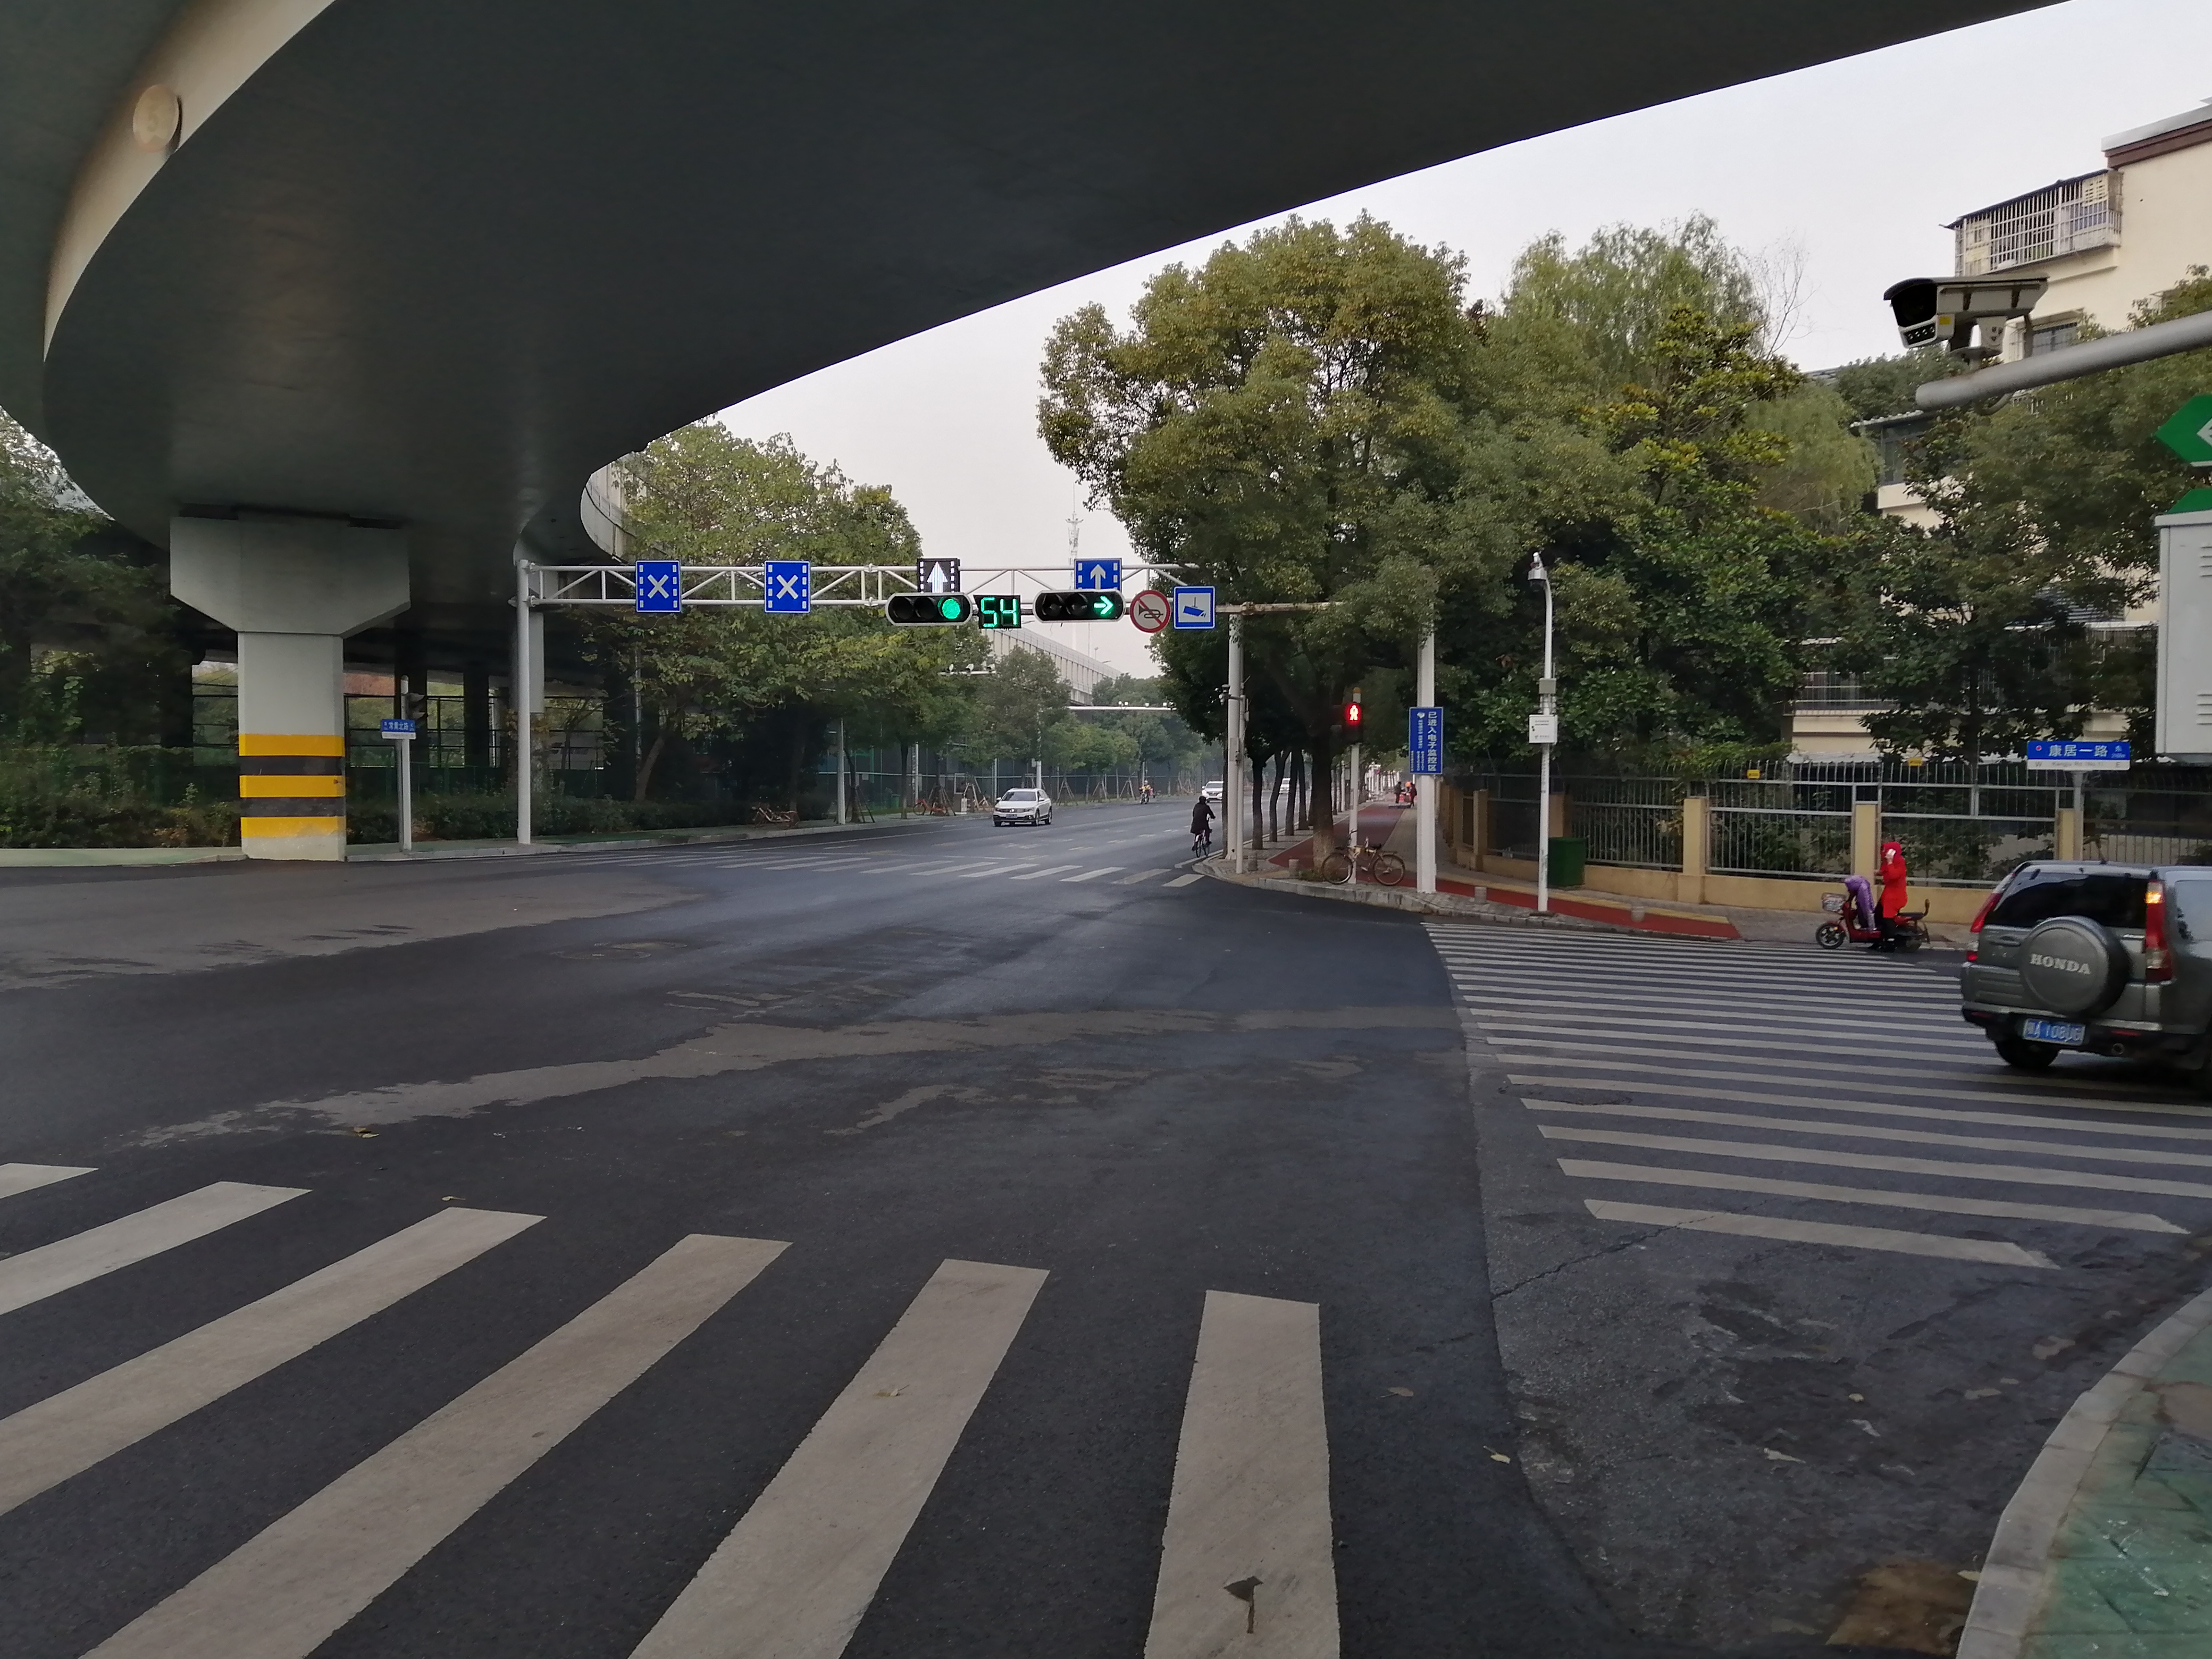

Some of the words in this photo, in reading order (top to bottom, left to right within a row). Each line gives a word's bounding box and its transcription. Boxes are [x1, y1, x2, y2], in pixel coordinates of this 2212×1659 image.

[981, 597, 1018, 627] 54
[1427, 711, 1437, 771] 已进入电子监控区
[2048, 744, 2108, 757] 康居一路
[2030, 953, 2091, 974] HONDA
